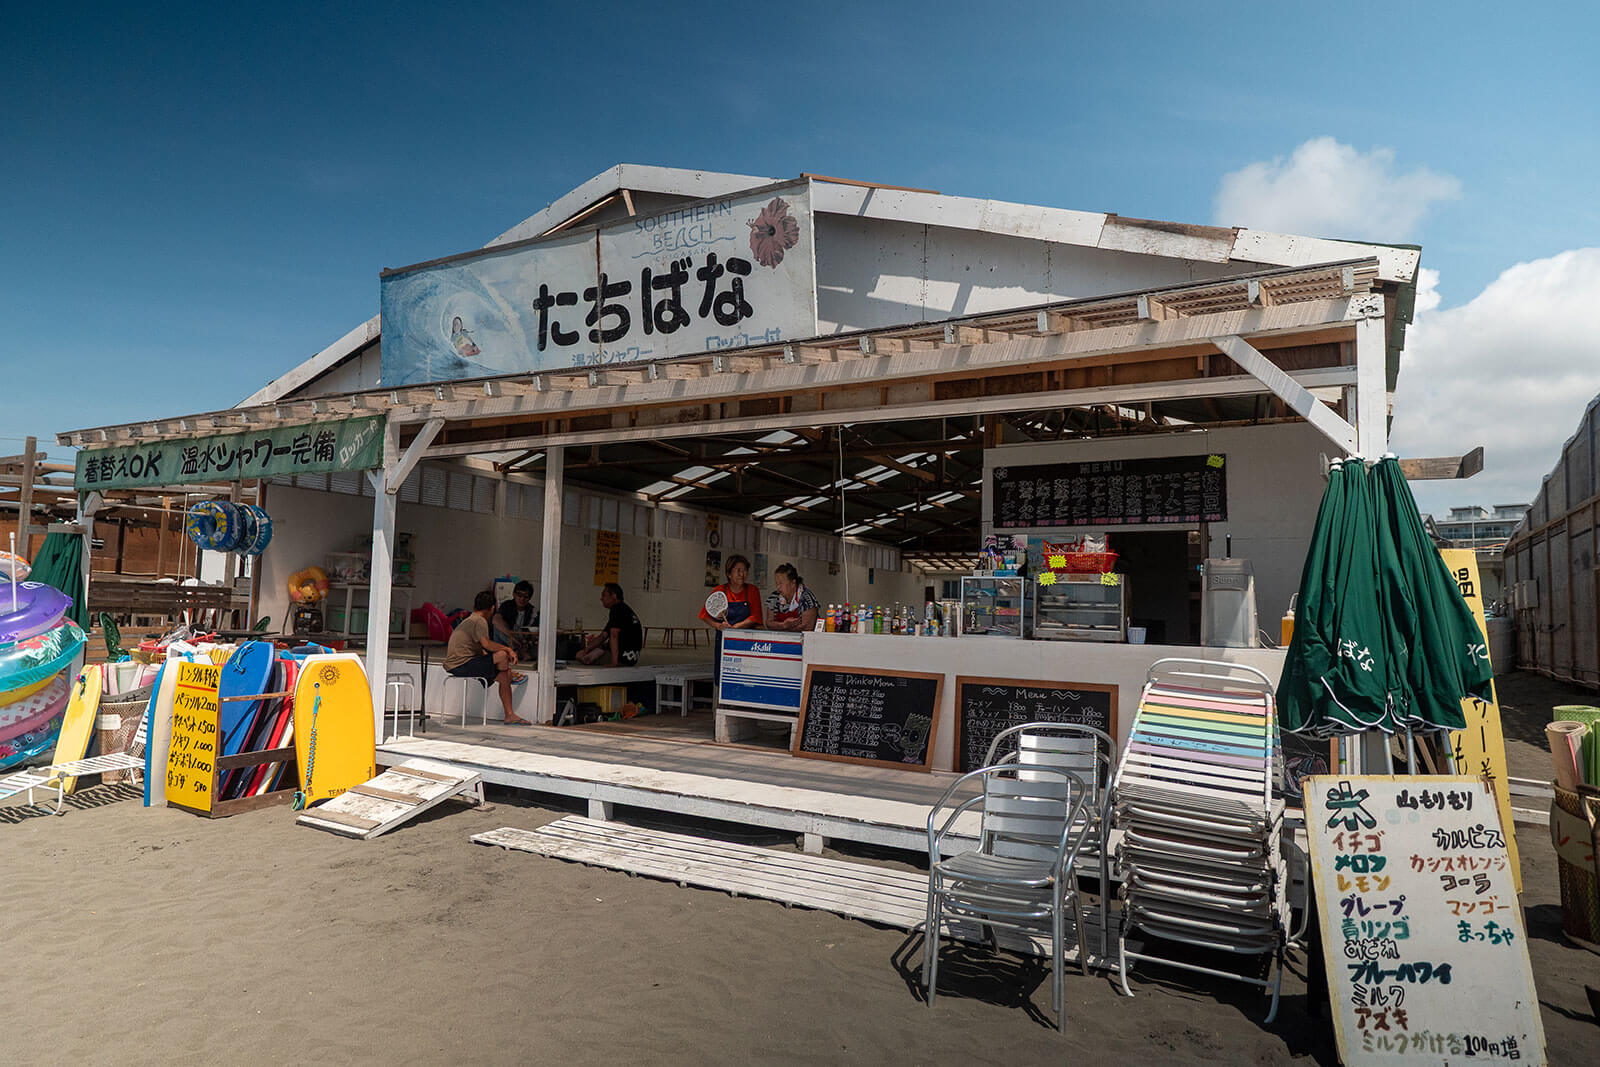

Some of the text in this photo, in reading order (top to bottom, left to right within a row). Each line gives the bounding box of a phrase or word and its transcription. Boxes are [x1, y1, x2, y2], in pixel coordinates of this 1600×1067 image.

[635, 199, 732, 235] SOUTHERN
[653, 224, 712, 249] BEACH
[655, 247, 711, 262] CHIGASAKI
[533, 252, 753, 351] たちばな
[572, 347, 653, 367] 温水シャワー
[85, 450, 162, 483] 着替えOK
[750, 641, 774, 652] Asahi
[1015, 688, 1048, 700] Menu
[1396, 789, 1472, 811] 山もりもり
[1332, 823, 1506, 852] イチゴ カルピス
[1335, 853, 1509, 873] メロン カシスオレンジ
[1337, 873, 1492, 895] レモン コーラ
[1340, 894, 1511, 918] グレープ マンゴー
[1341, 916, 1514, 945] 青リンゴ まっちゃ
[1347, 960, 1452, 985] ブルーハワイ
[1351, 983, 1405, 1007] ミルク
[1354, 1006, 1408, 1031] アズキ
